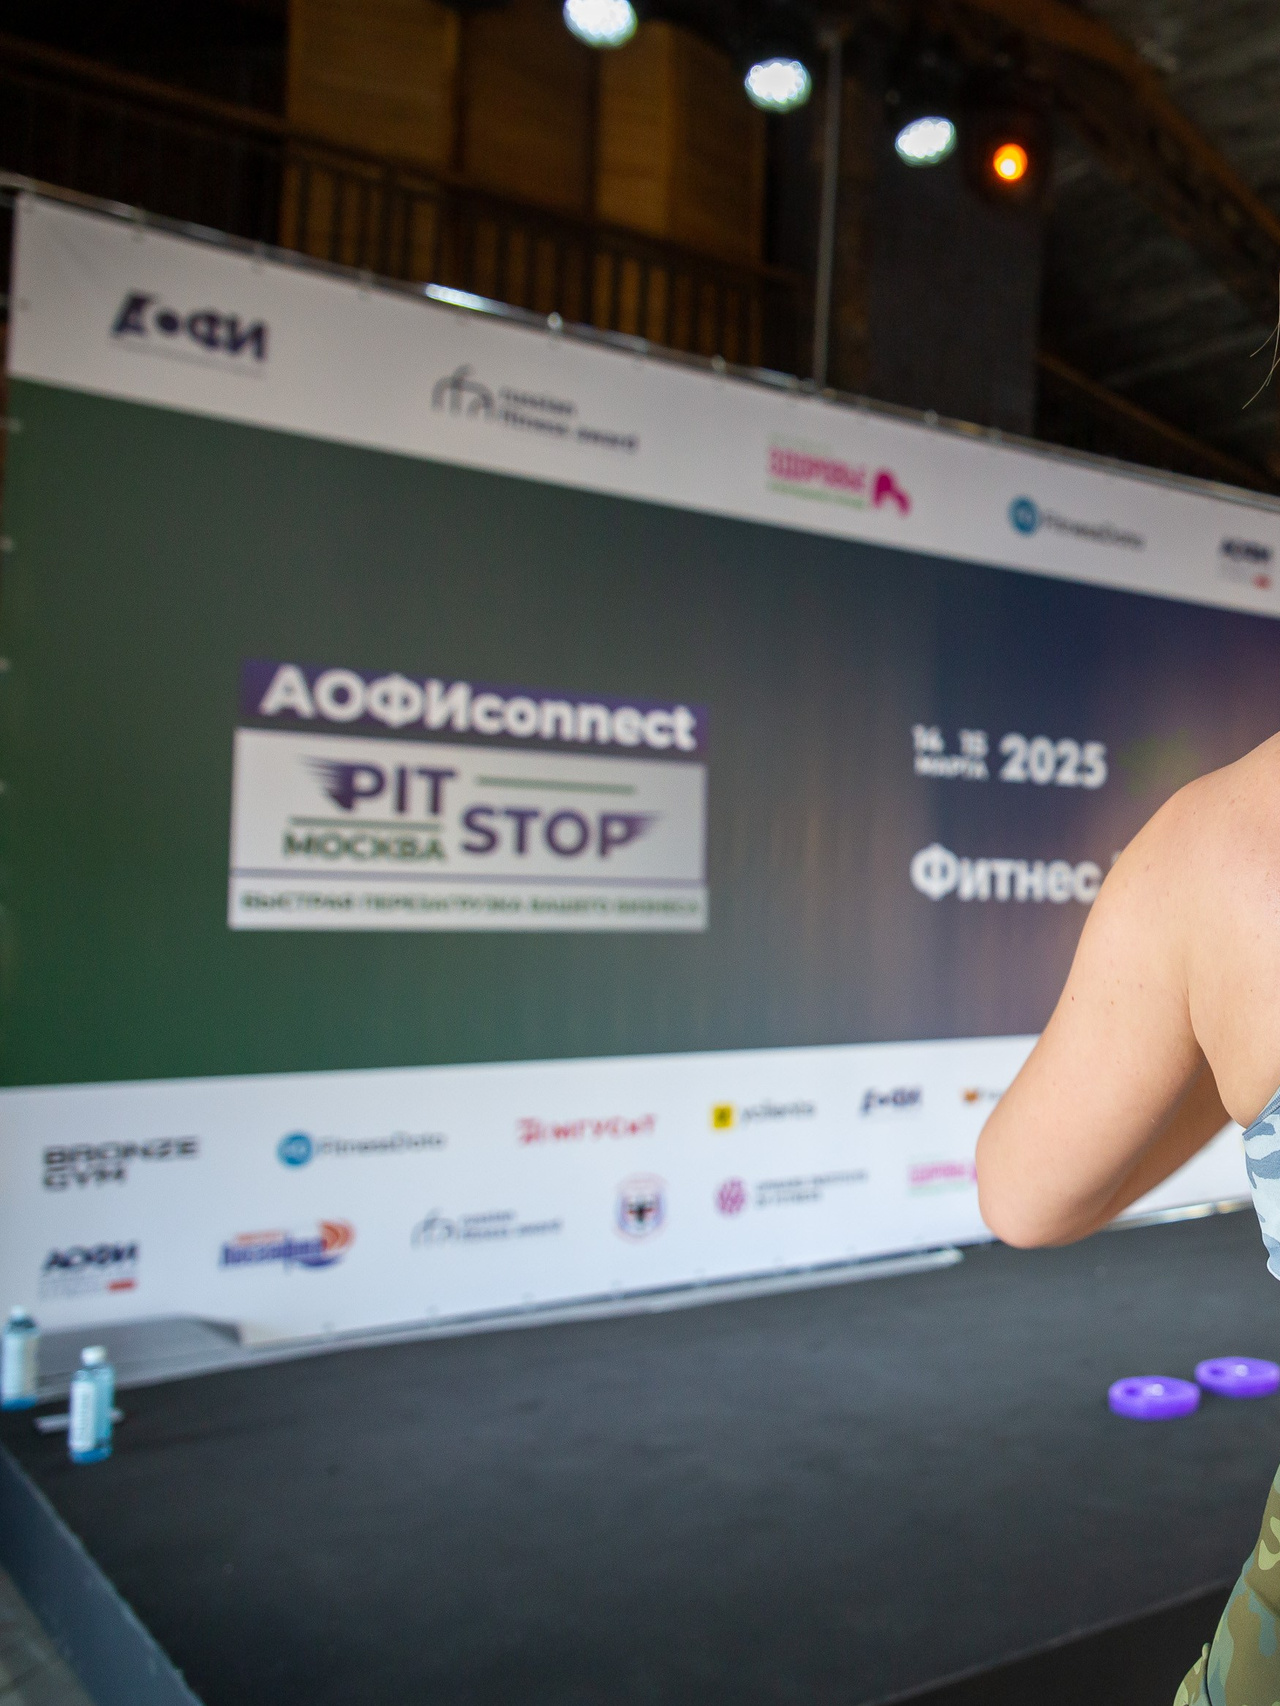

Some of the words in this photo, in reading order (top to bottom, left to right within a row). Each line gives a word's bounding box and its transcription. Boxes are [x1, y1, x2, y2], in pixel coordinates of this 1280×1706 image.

[258, 663, 697, 752] АОФИconnect
[300, 755, 457, 816] PIT
[1000, 732, 1107, 789] 2025
[461, 805, 665, 860] STOP
